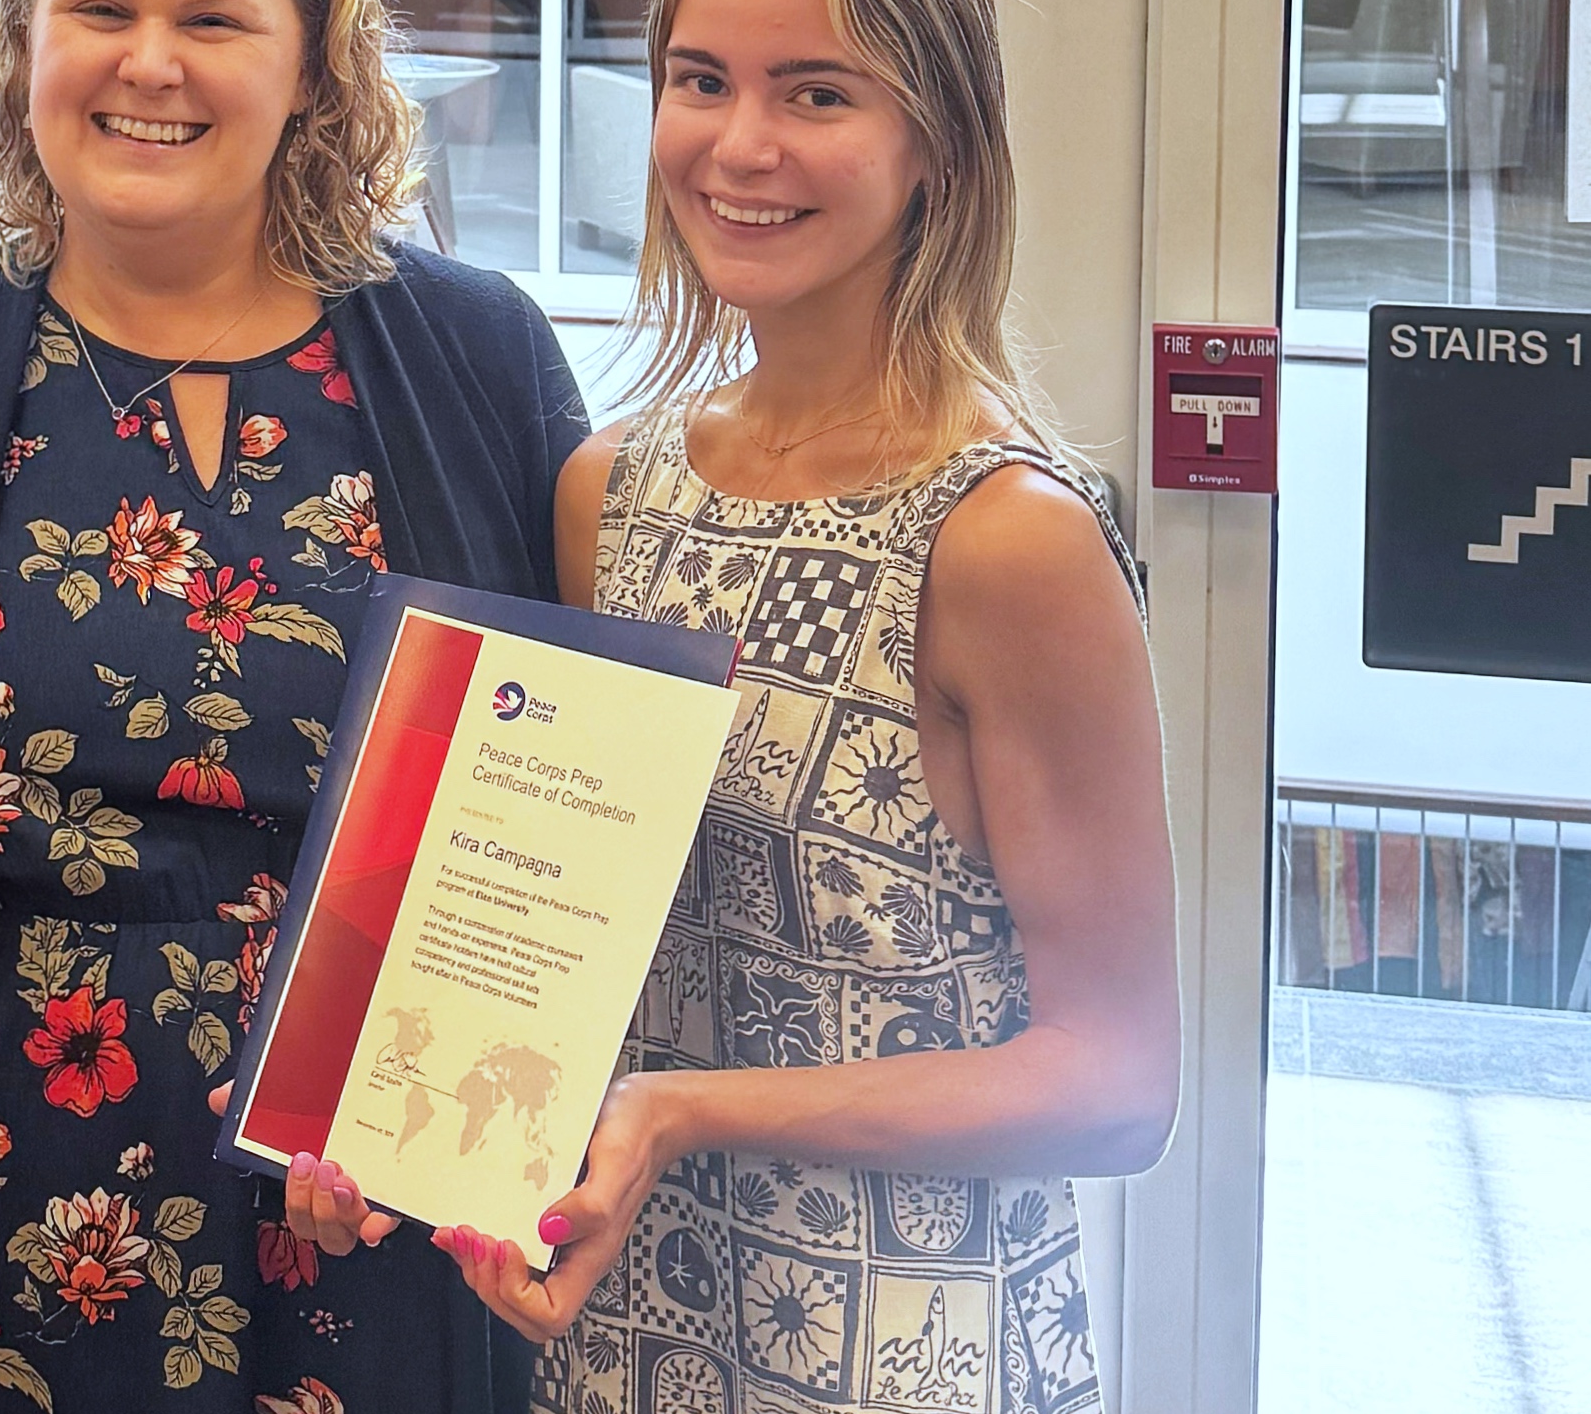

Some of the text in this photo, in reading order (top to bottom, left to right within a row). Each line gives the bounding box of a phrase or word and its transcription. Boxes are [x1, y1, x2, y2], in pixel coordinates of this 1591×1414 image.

[1164, 335, 1276, 357] FIRE ALARM
[1389, 324, 1581, 366] STAIRS 1
[1180, 399, 1251, 413] PULL DOWN
[525, 707, 554, 724] Corps
[528, 696, 557, 713] Peace
[477, 741, 604, 794] Peace Corps Prep
[471, 763, 636, 827] Certificate of Completion
[449, 828, 563, 881] Kira Campagna
